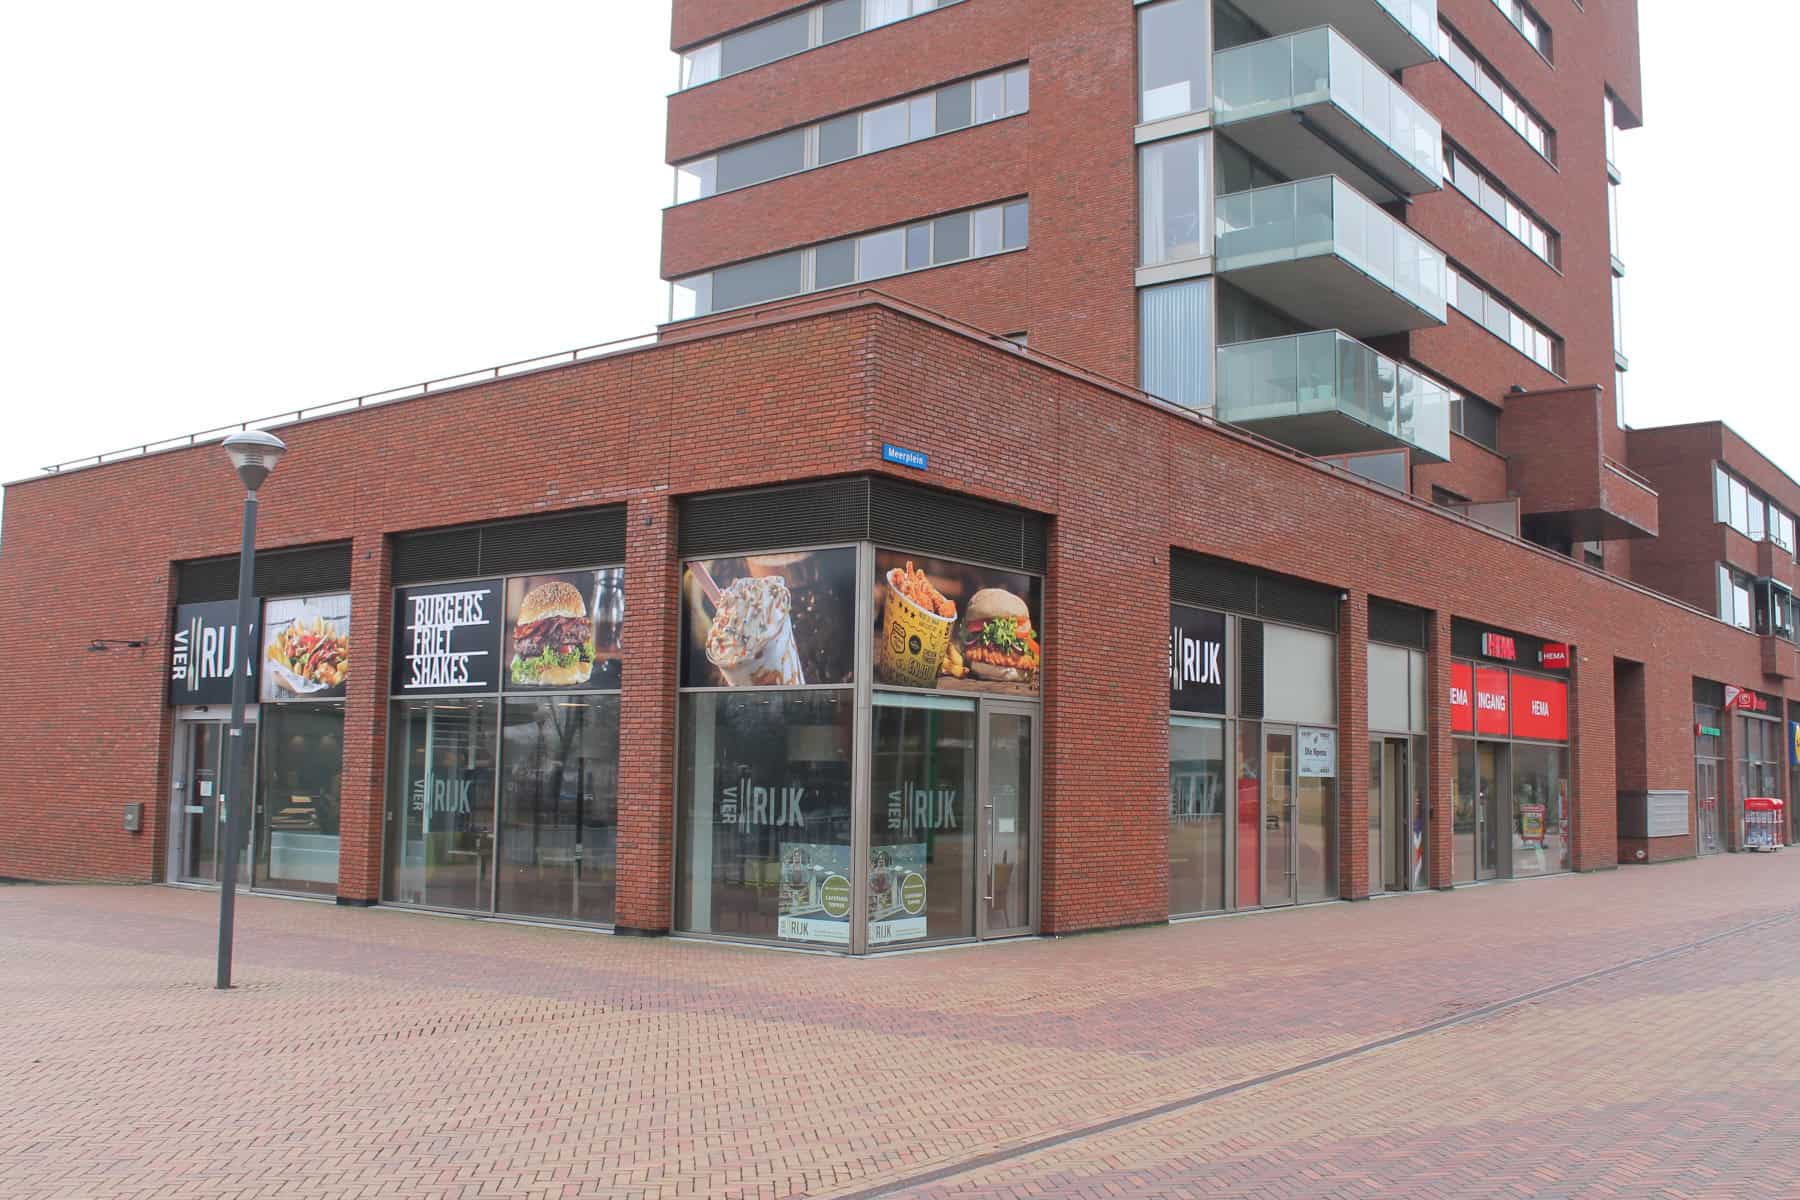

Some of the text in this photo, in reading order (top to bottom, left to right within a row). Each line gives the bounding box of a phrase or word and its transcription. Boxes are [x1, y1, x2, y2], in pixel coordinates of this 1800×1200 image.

[888, 447, 924, 465] Meerplein
[414, 592, 484, 626] BURGERS
[172, 629, 189, 681] VIER
[413, 625, 453, 656] FRIET
[1543, 652, 1566, 660] HEMA
[411, 655, 469, 687] SHAKES
[1183, 637, 1221, 685] RIJK
[1477, 691, 1506, 712] INGANG
[1531, 700, 1550, 717] HEMA
[412, 779, 472, 813] VIER RIJK
[720, 786, 805, 828] VIER RIJK
[887, 790, 957, 830] VIER RIJK
[791, 921, 809, 937] RIJK
